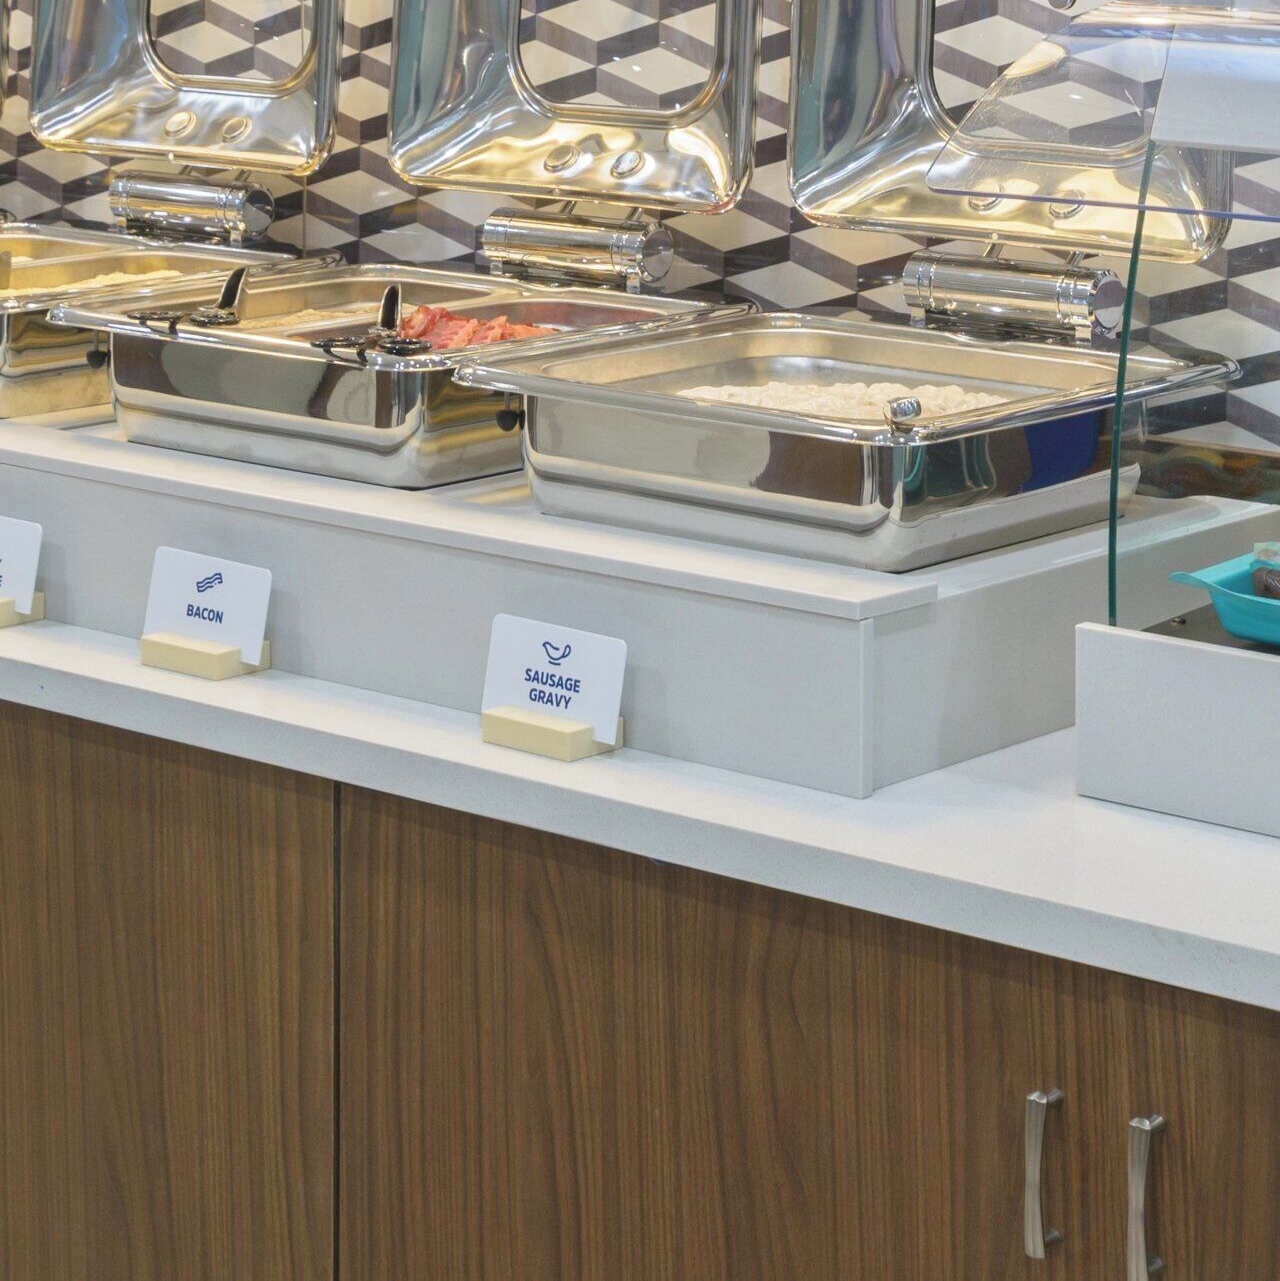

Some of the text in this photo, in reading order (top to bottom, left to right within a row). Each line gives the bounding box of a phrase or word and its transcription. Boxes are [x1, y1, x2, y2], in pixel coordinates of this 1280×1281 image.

[186, 604, 223, 624] BACON
[524, 668, 581, 693] SAUSAGE
[529, 688, 572, 709] GRAVY
